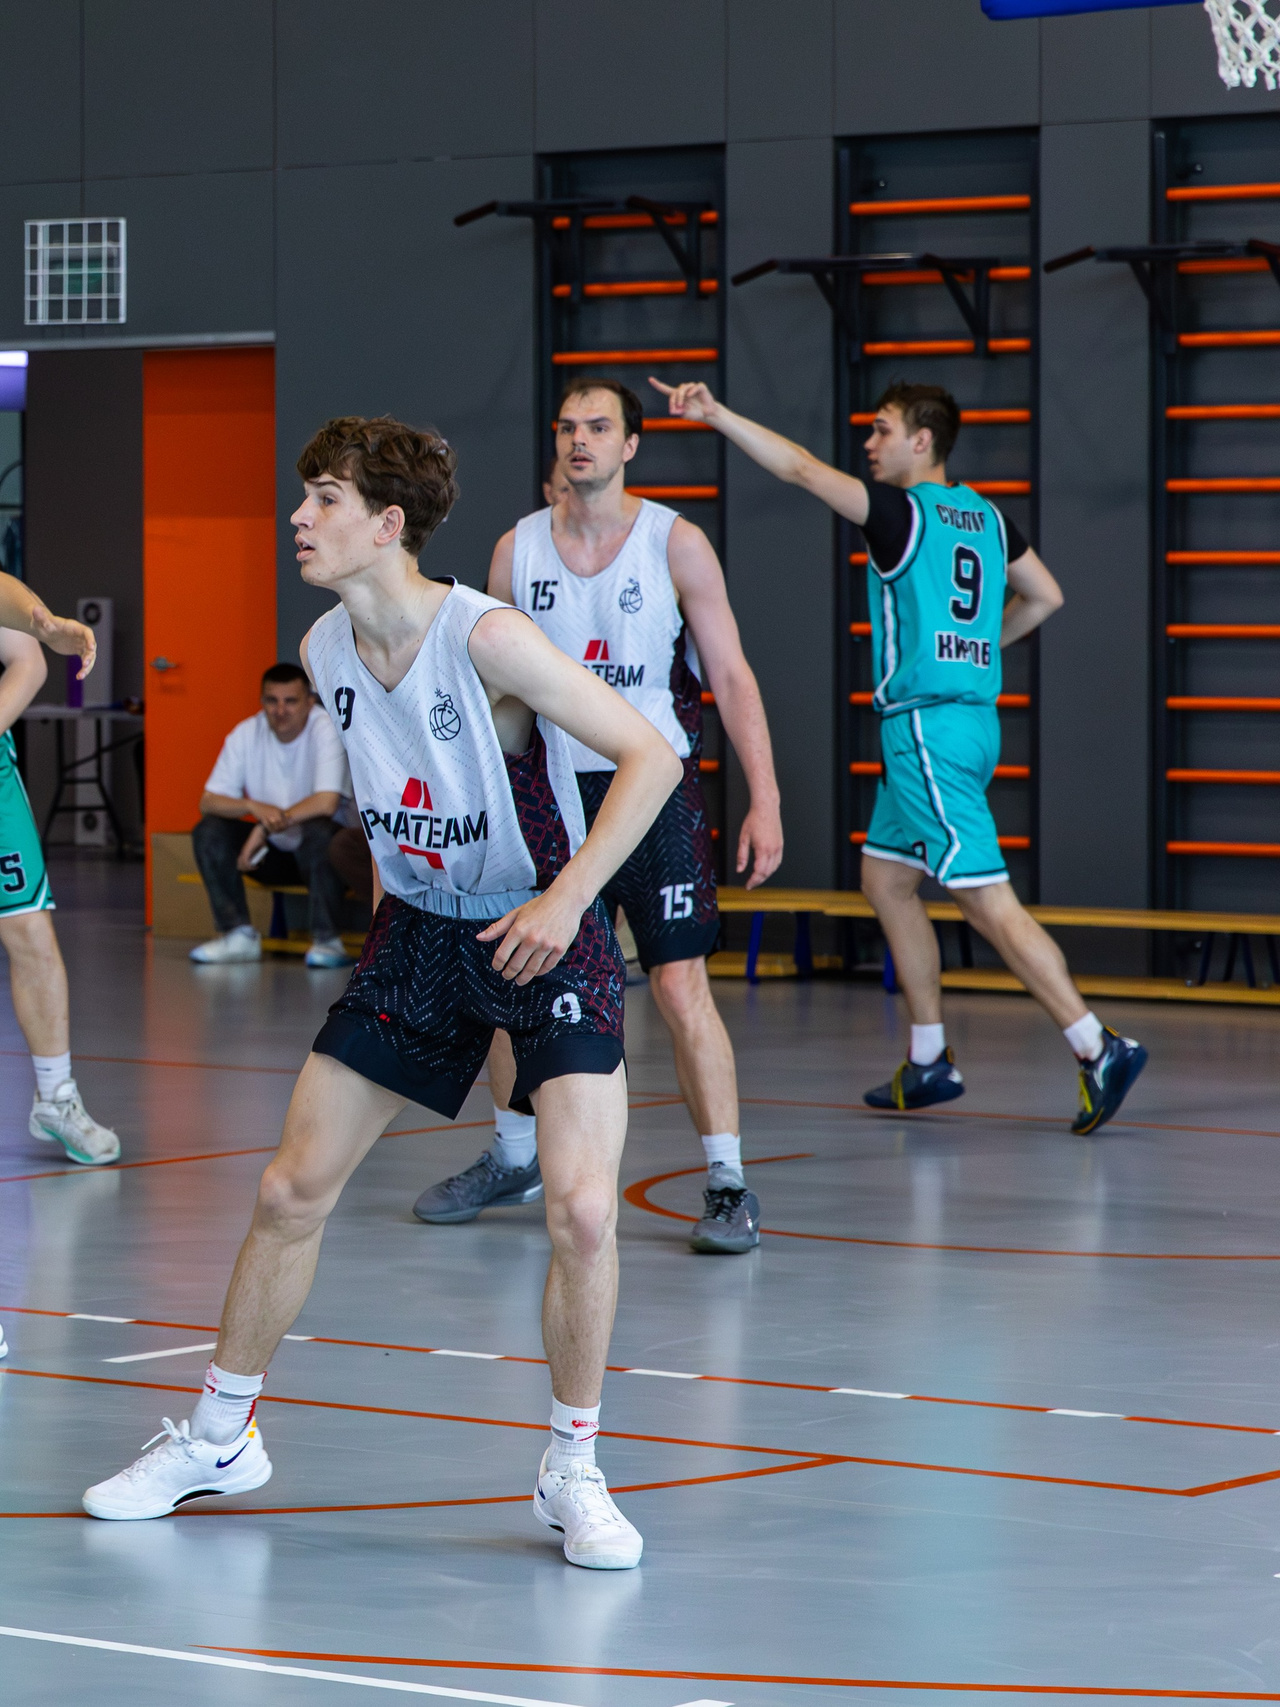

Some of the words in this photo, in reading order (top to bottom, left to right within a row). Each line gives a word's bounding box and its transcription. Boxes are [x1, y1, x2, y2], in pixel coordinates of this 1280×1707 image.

[531, 580, 559, 612] 15
[949, 541, 984, 625] 9
[334, 686, 356, 731] 9
[659, 882, 694, 921] 15
